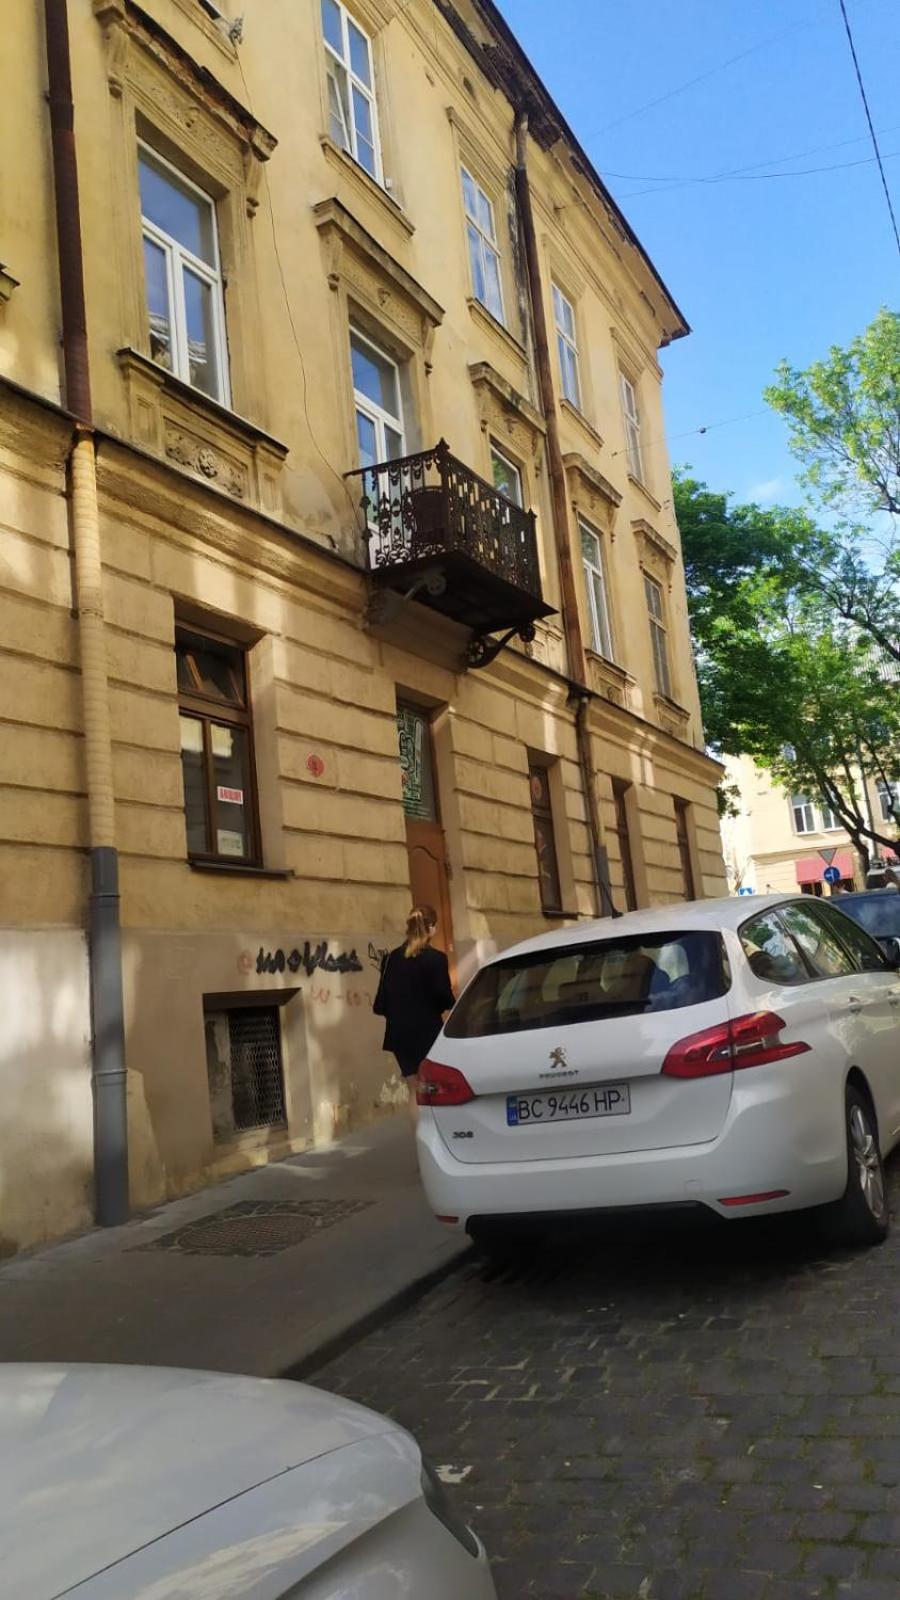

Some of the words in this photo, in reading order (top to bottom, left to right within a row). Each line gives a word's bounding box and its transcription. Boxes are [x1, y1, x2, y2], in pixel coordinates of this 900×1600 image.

[518, 1099, 543, 1120] BC
[547, 1092, 590, 1117] 9446
[594, 1089, 621, 1112] HP
